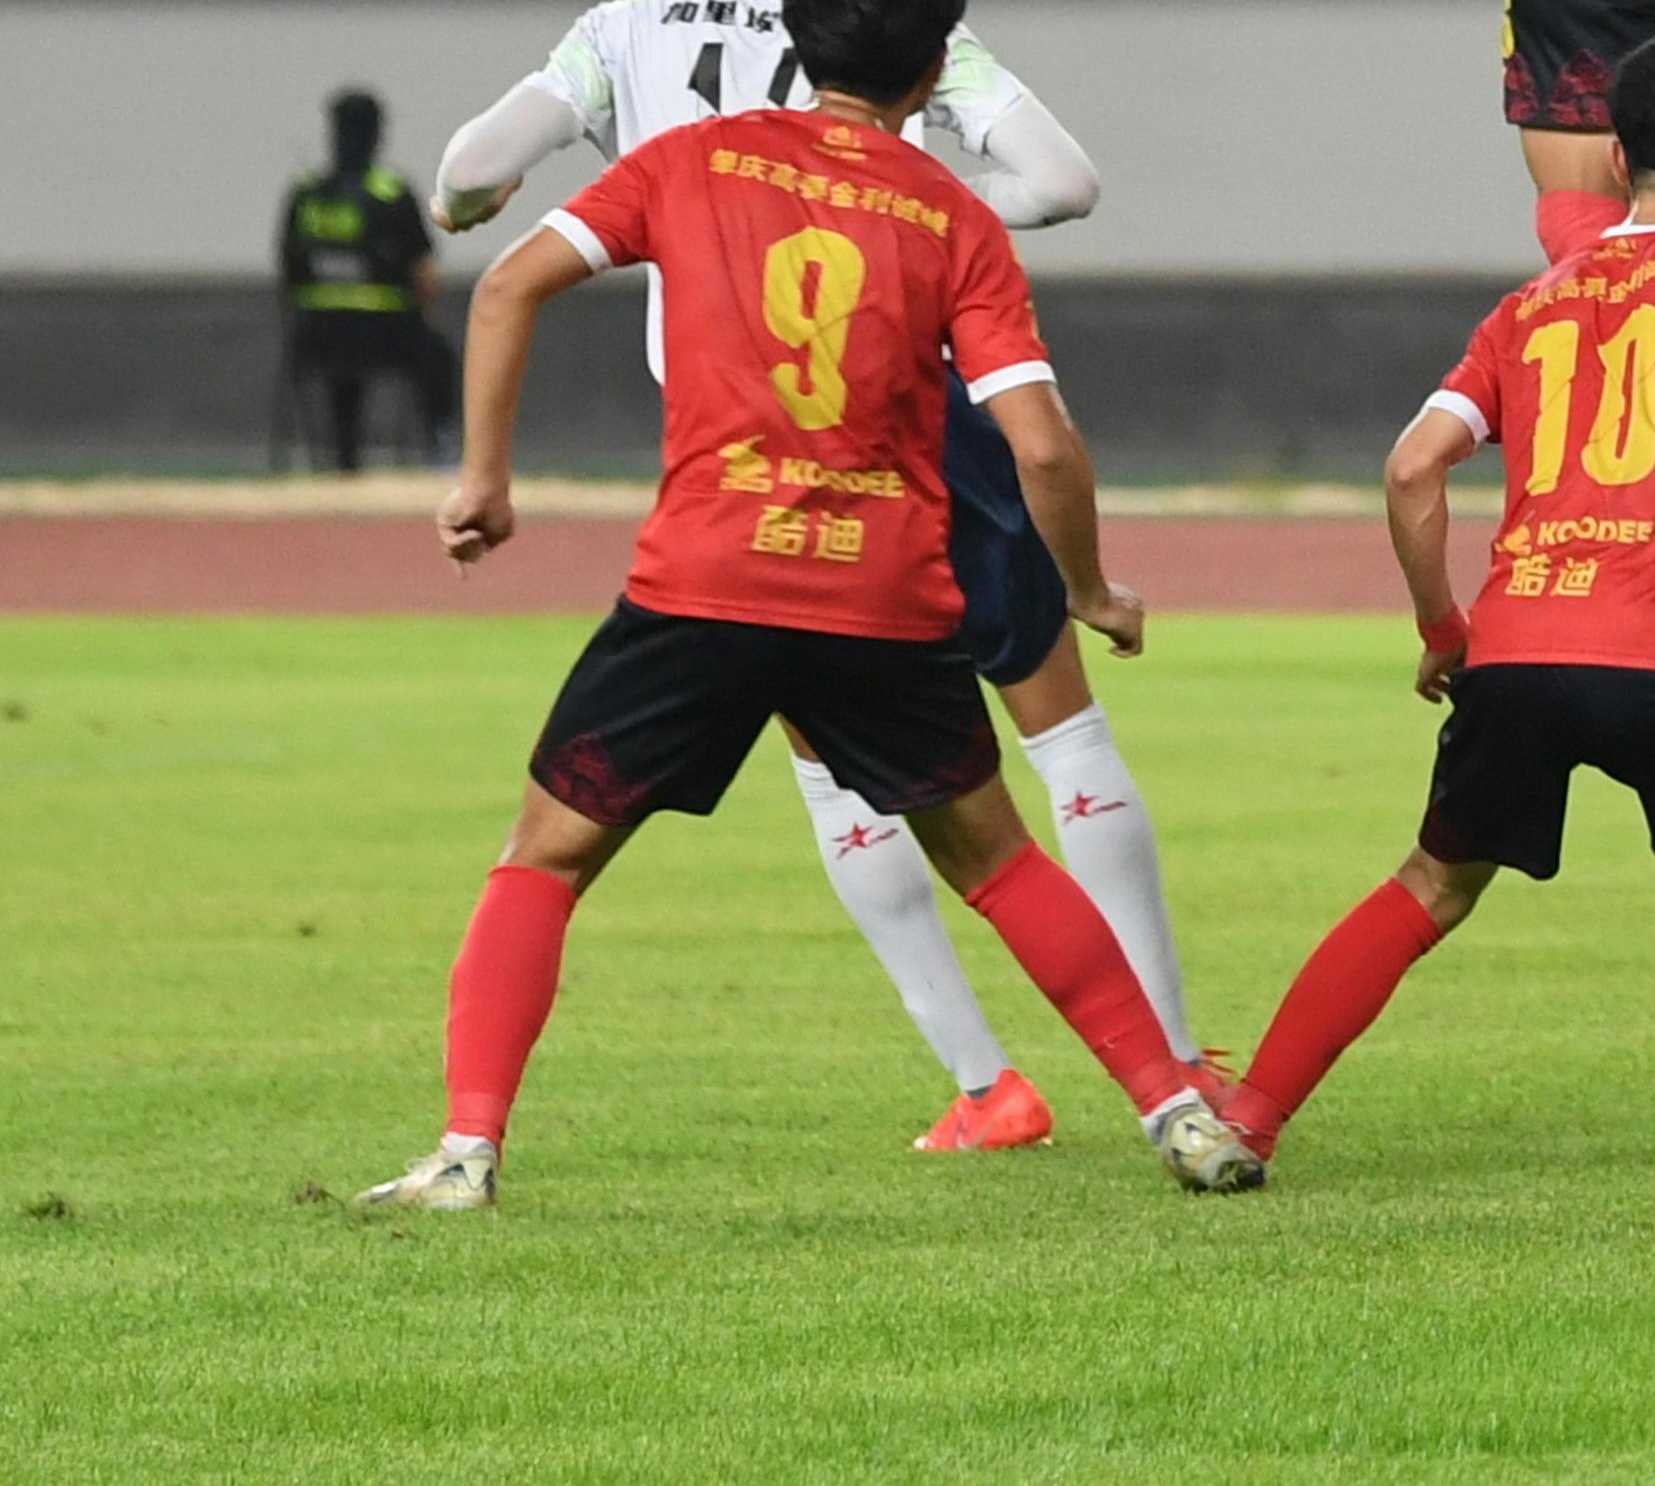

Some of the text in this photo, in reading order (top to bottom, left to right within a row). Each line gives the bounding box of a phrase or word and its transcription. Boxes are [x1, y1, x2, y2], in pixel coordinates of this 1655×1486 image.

[762, 225, 867, 431] 9
[751, 505, 865, 563] 酷迪
[1536, 515, 1655, 548] KOODEE
[1505, 552, 1600, 598] 酷迪
